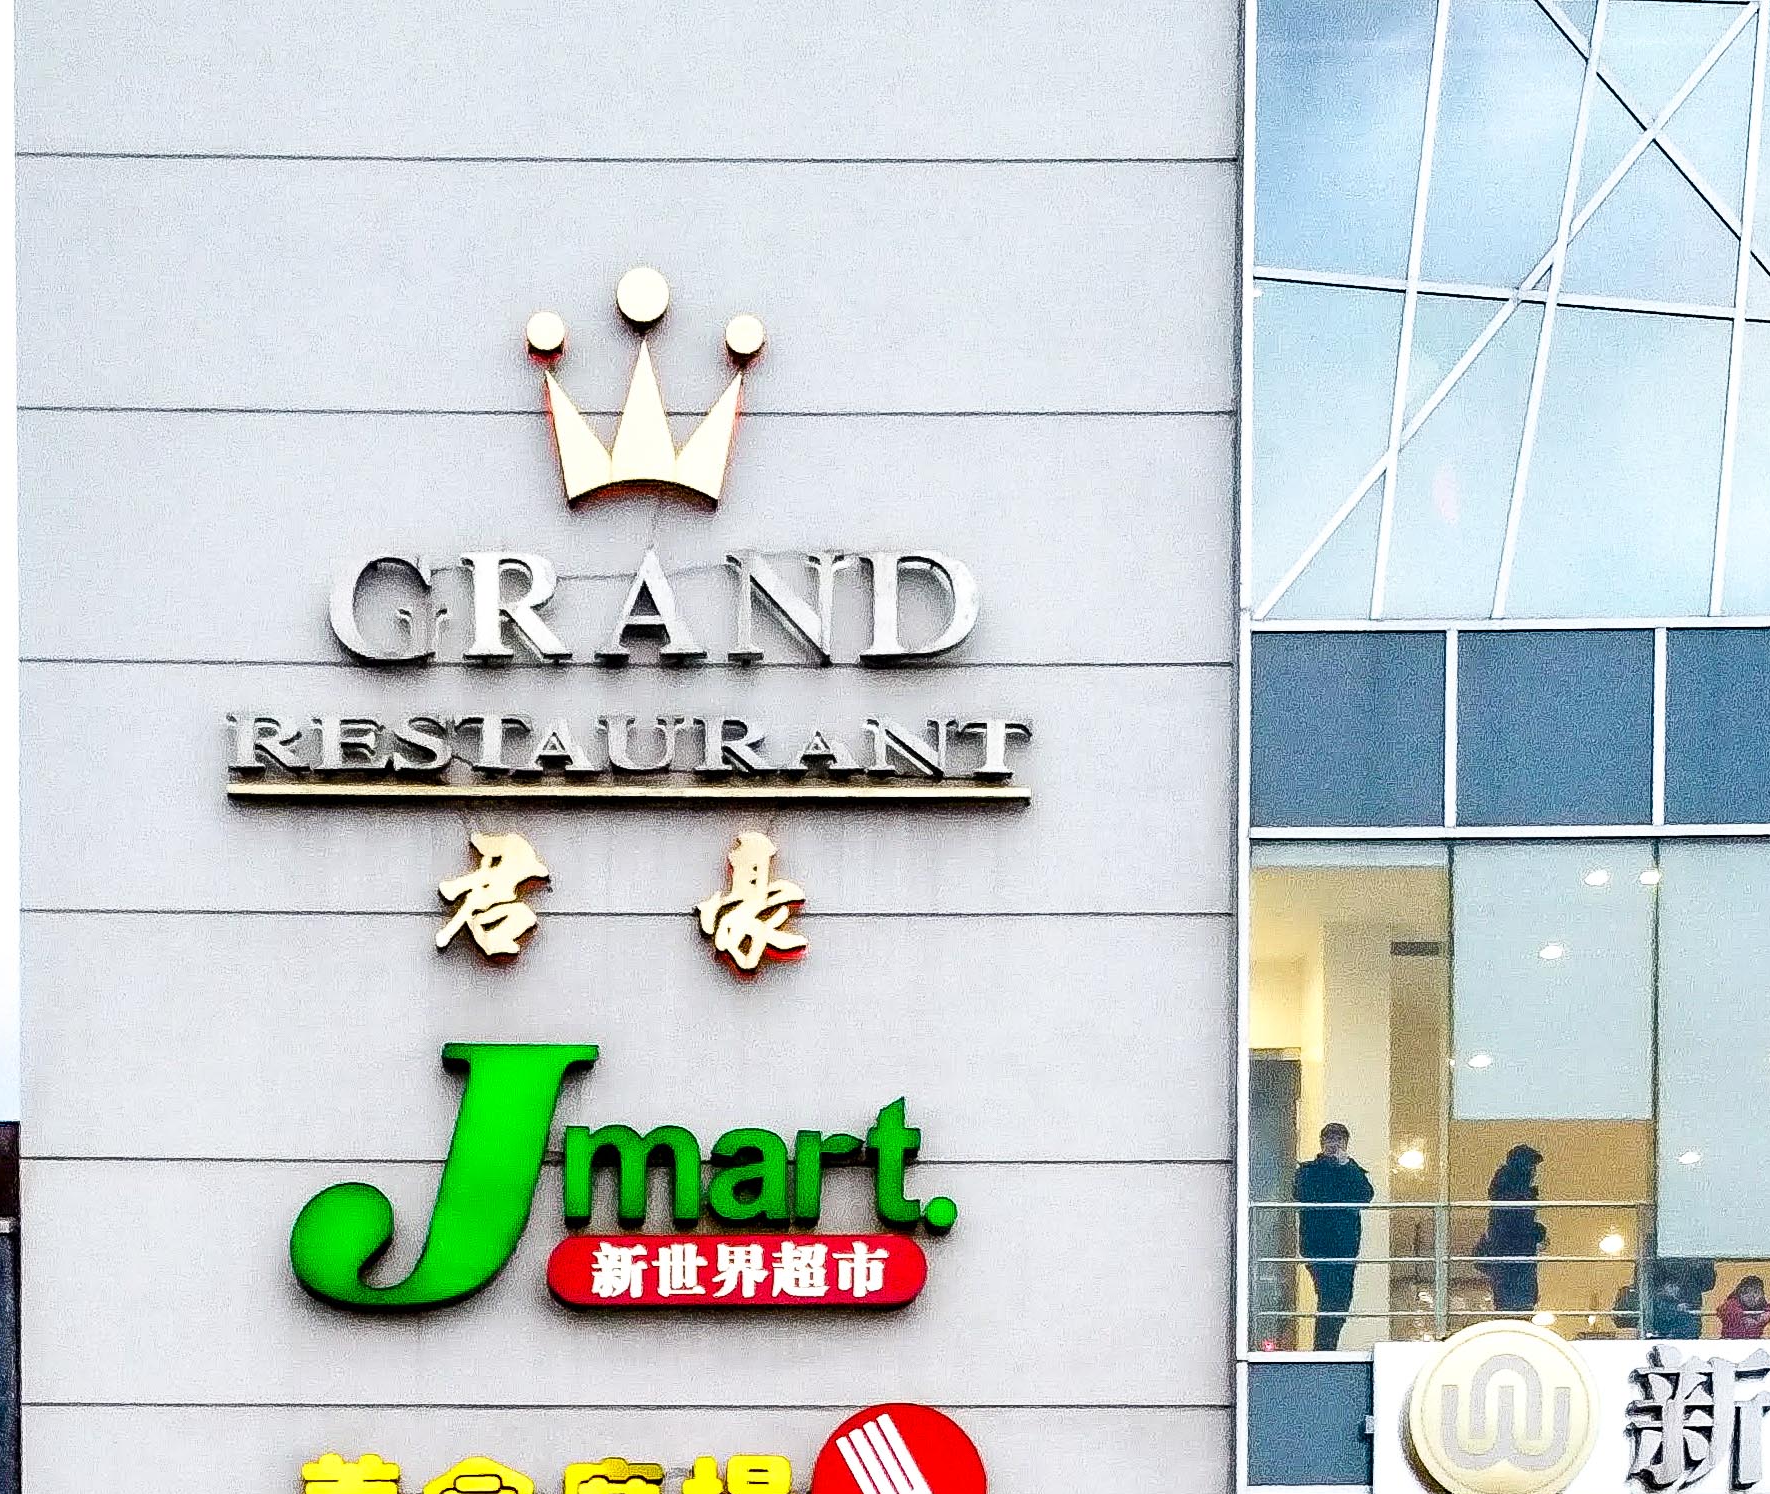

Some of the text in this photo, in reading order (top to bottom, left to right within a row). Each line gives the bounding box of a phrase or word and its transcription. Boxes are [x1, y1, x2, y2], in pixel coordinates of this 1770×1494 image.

[328, 548, 981, 667] GRAND
[226, 713, 1031, 779] RESTAURANT
[435, 831, 808, 972] 君豪
[590, 1240, 889, 1300] 新世界超市
